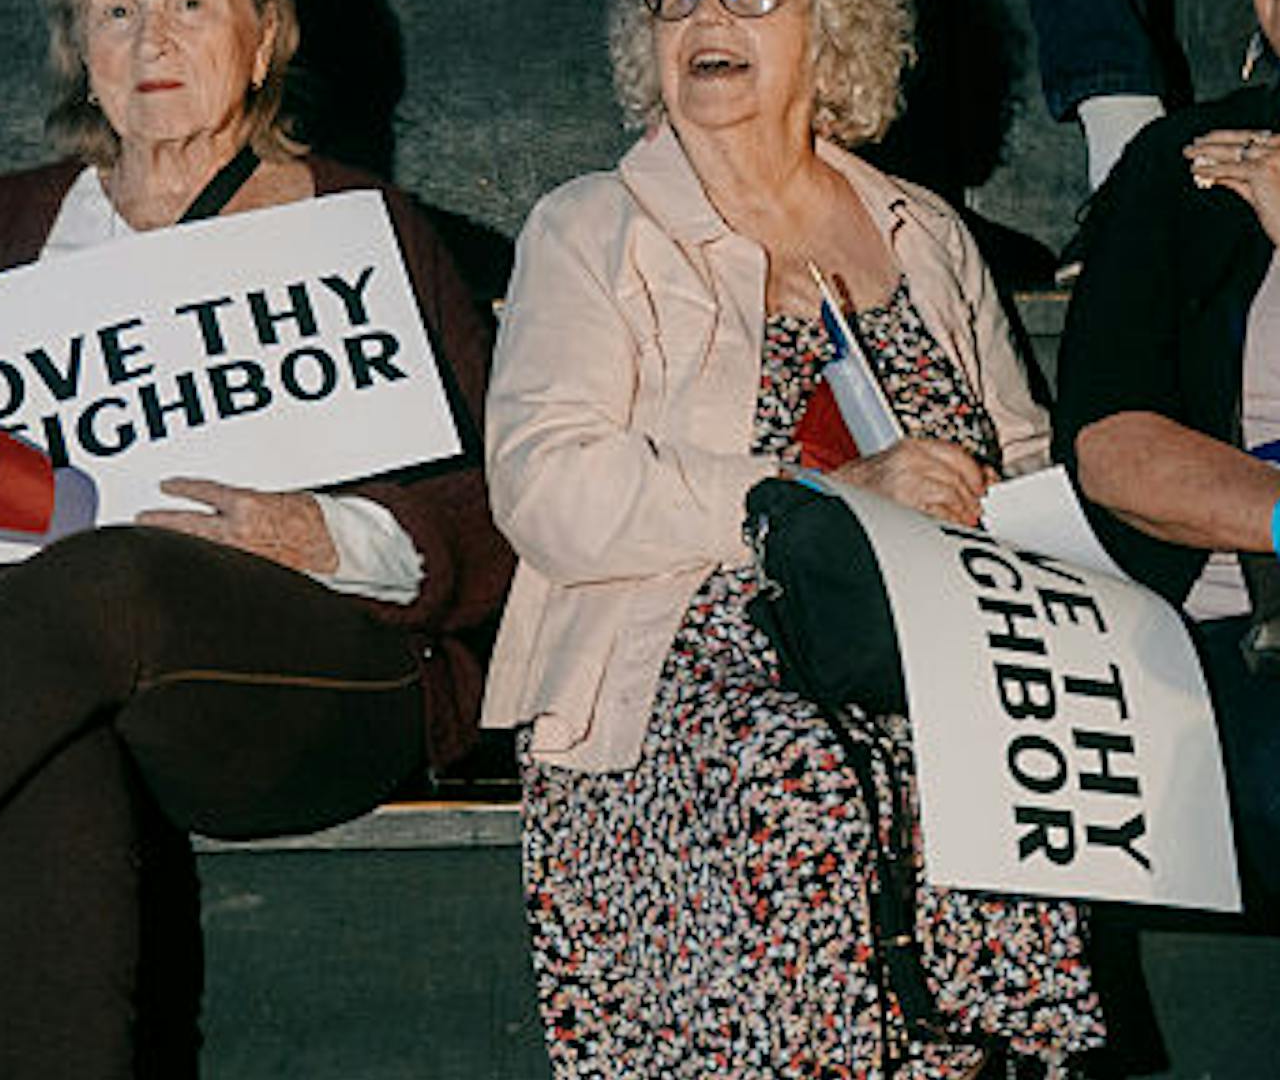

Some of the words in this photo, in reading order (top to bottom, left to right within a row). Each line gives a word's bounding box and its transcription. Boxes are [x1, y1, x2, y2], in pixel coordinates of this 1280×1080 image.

[0, 331, 408, 469] IGHBOR
[176, 266, 377, 357] THY
[940, 525, 1077, 867] IGHBOR
[1012, 549, 1108, 634] VE
[1064, 662, 1154, 874] THY
